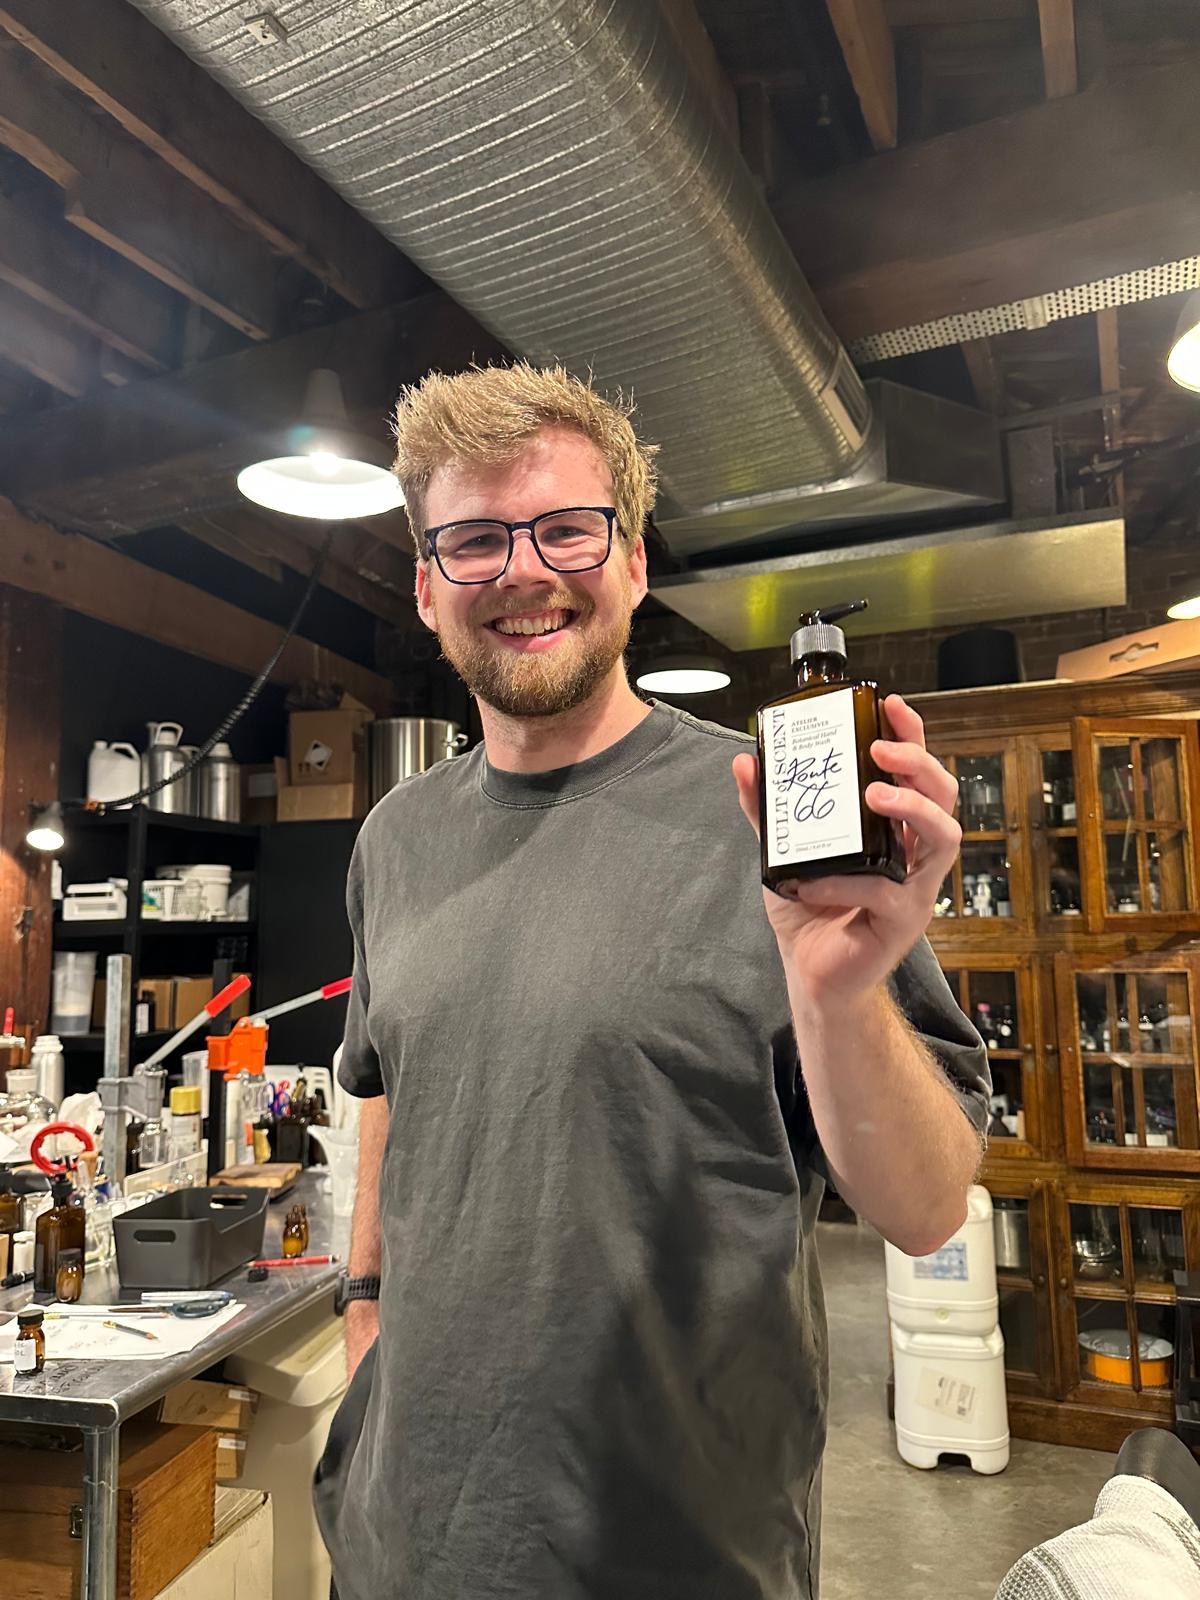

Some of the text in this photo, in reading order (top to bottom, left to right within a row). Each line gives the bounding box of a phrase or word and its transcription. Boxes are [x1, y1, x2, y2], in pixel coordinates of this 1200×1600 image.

[791, 716, 818, 727] ATELIER
[791, 720, 829, 733] EXCLUSIVES
[820, 728, 837, 739] Hand
[772, 709, 787, 775] SCENT
[798, 742, 814, 751] Body
[782, 747, 843, 791] Route
[793, 781, 836, 823] 66
[776, 797, 790, 855] CULT
